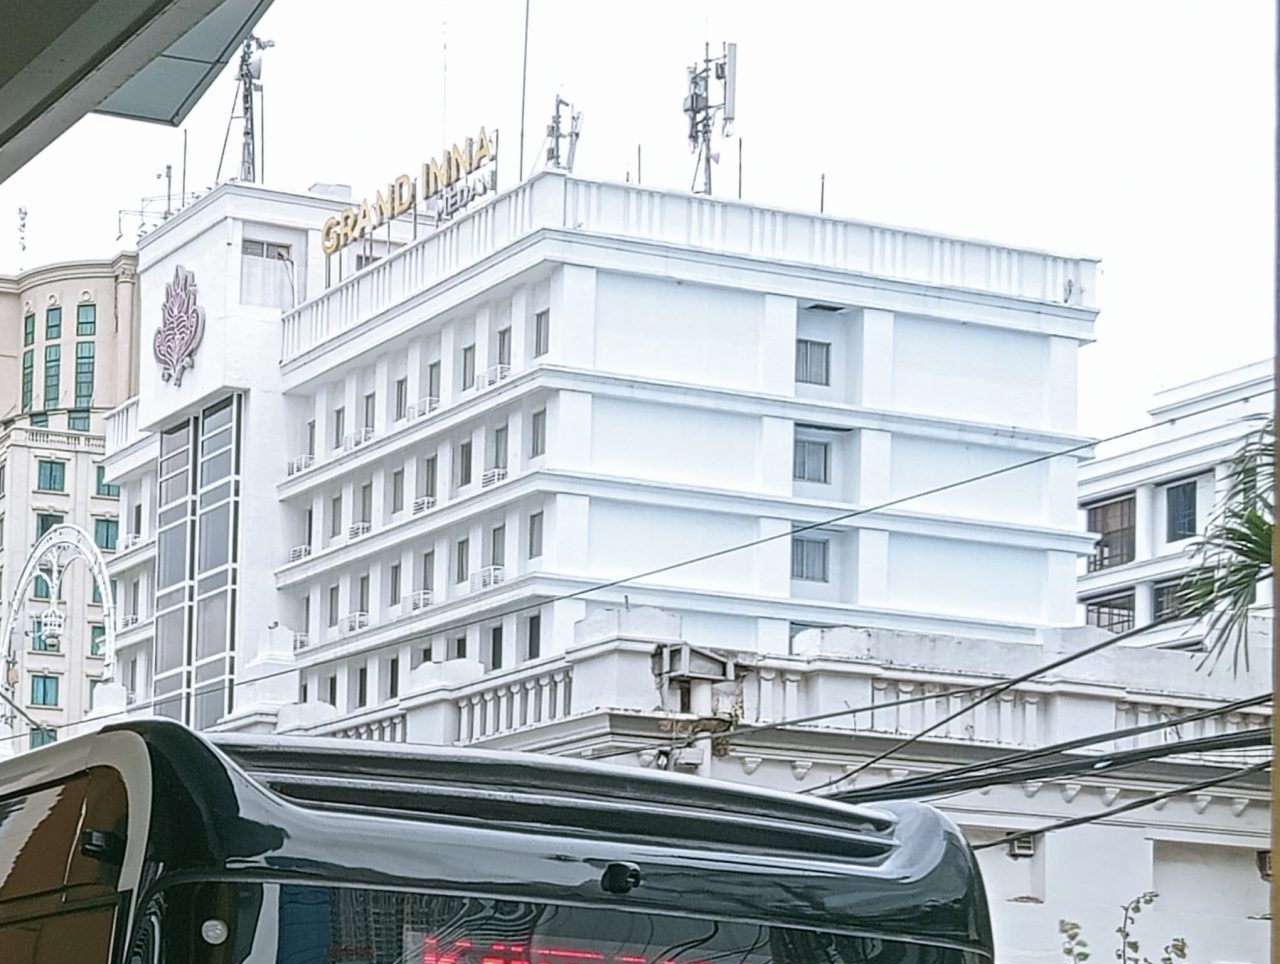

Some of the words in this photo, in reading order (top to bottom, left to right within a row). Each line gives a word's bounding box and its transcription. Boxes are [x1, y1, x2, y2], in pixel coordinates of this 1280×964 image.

[322, 173, 416, 255] GRAND
[422, 126, 495, 200] INNA
[434, 169, 496, 222] MEDAN
